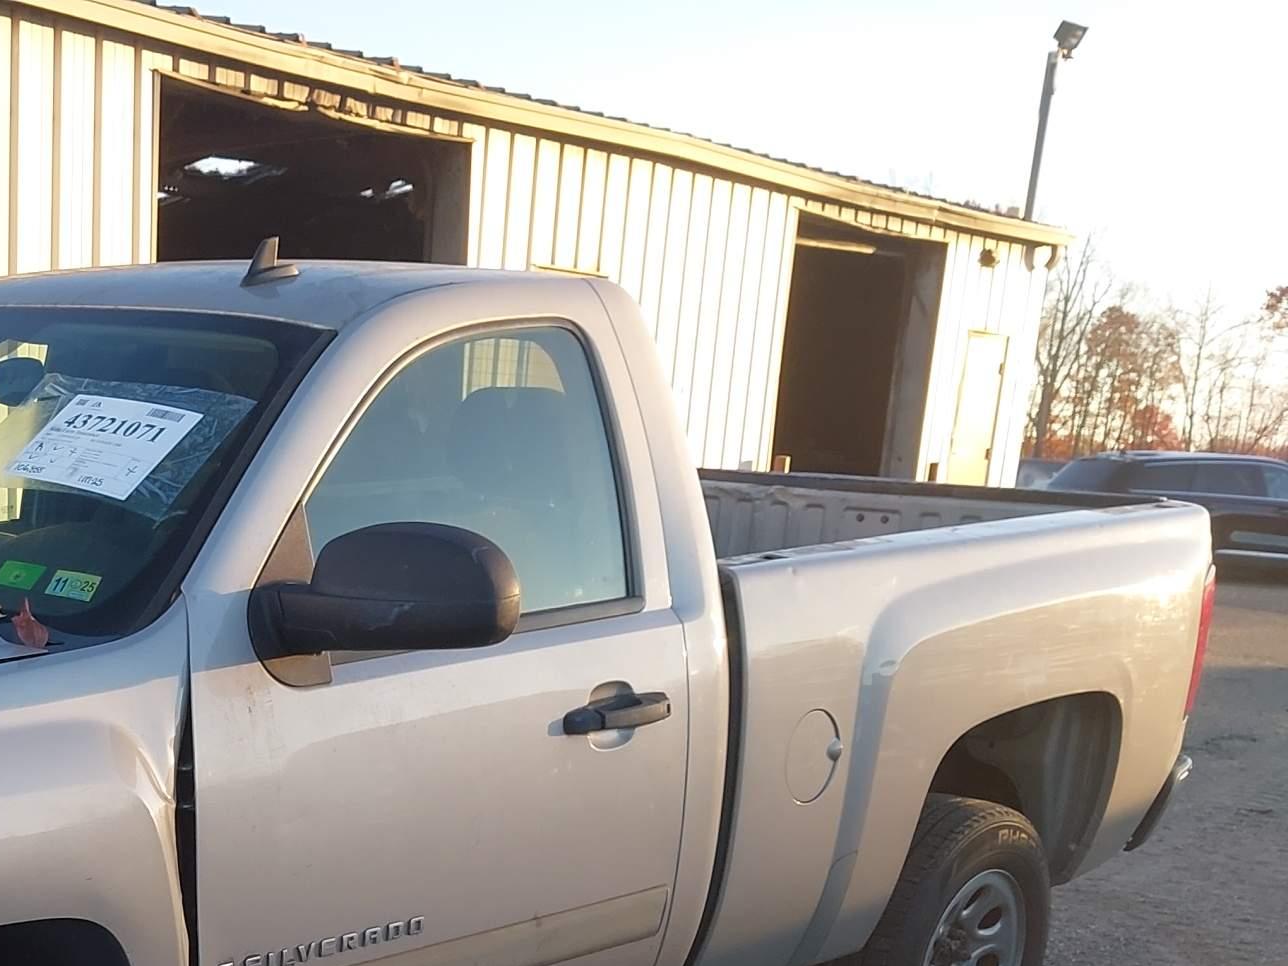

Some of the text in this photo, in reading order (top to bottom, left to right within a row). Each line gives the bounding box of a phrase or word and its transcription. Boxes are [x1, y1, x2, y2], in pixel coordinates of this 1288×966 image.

[64, 413, 167, 443] 43721071
[52, 577, 69, 593] 11
[80, 580, 97, 593] 25
